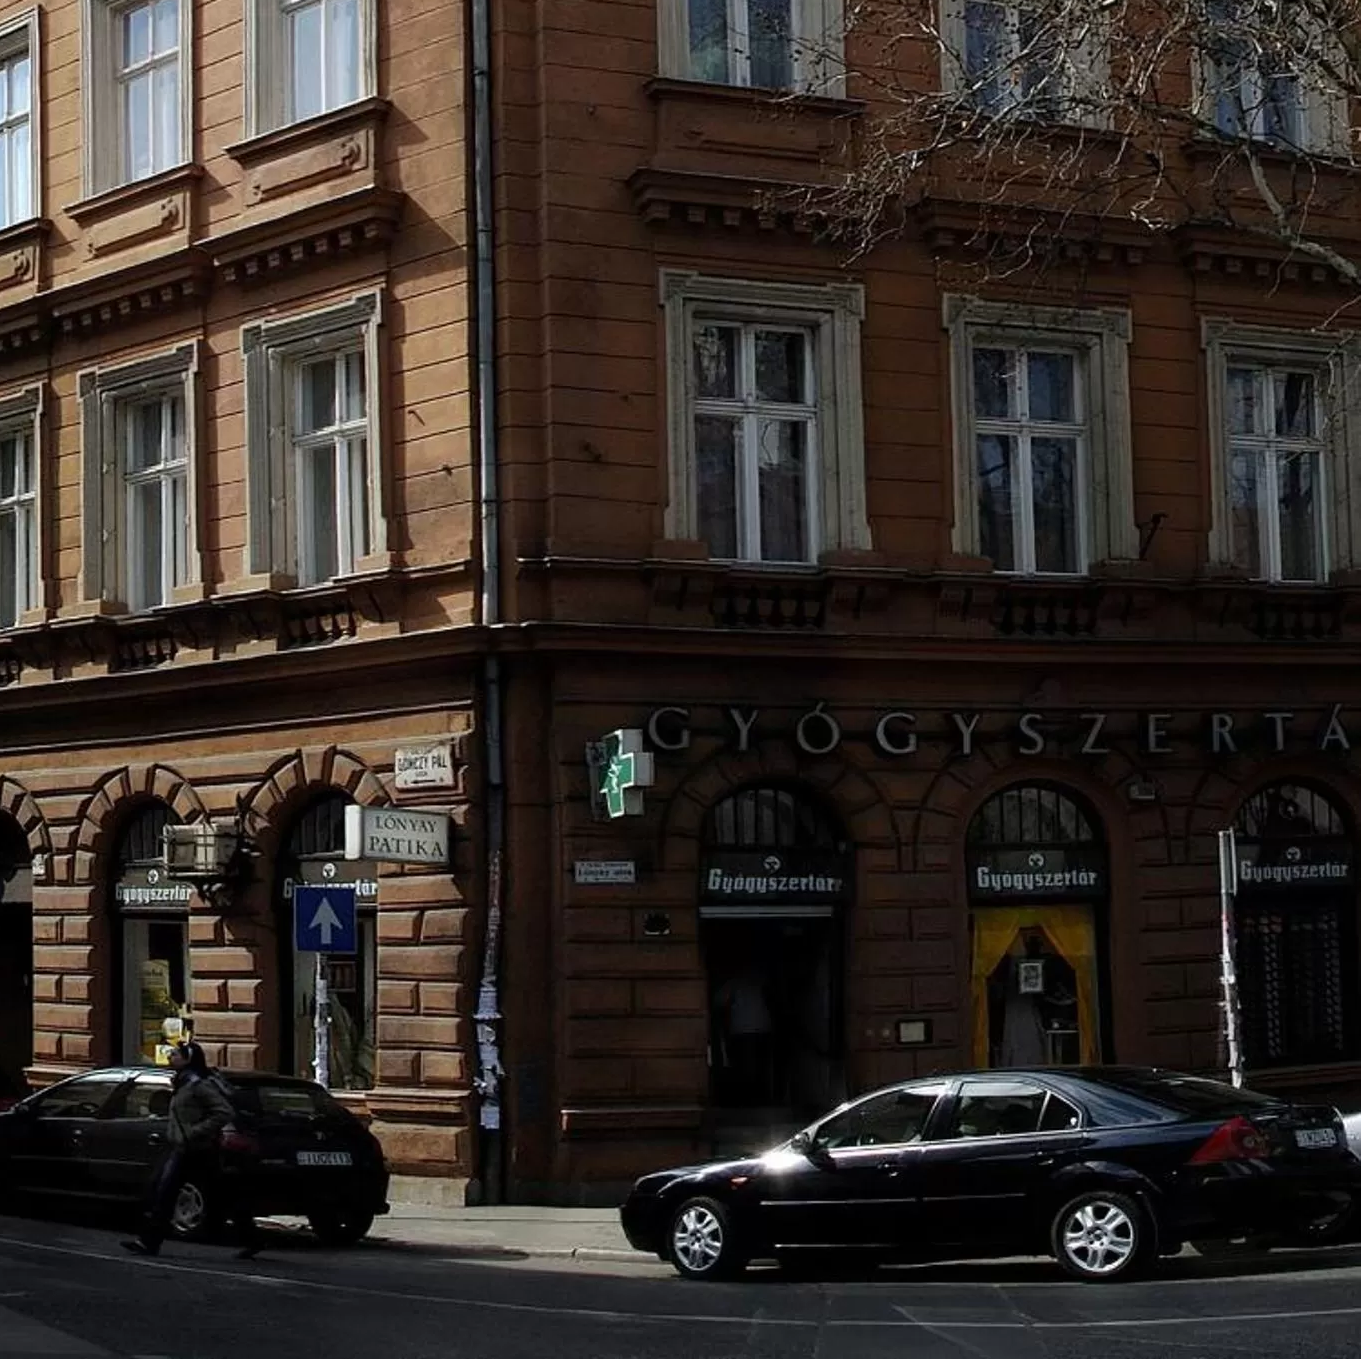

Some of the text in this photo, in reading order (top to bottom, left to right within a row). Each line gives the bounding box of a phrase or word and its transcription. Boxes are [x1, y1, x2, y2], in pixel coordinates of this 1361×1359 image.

[375, 814, 437, 833] LÓNYAY
[368, 836, 445, 857] PATIKA
[707, 867, 843, 894] Gyógyszertár
[976, 865, 1099, 892] Gyógyszertár
[1241, 860, 1348, 884] Gyógyszertár
